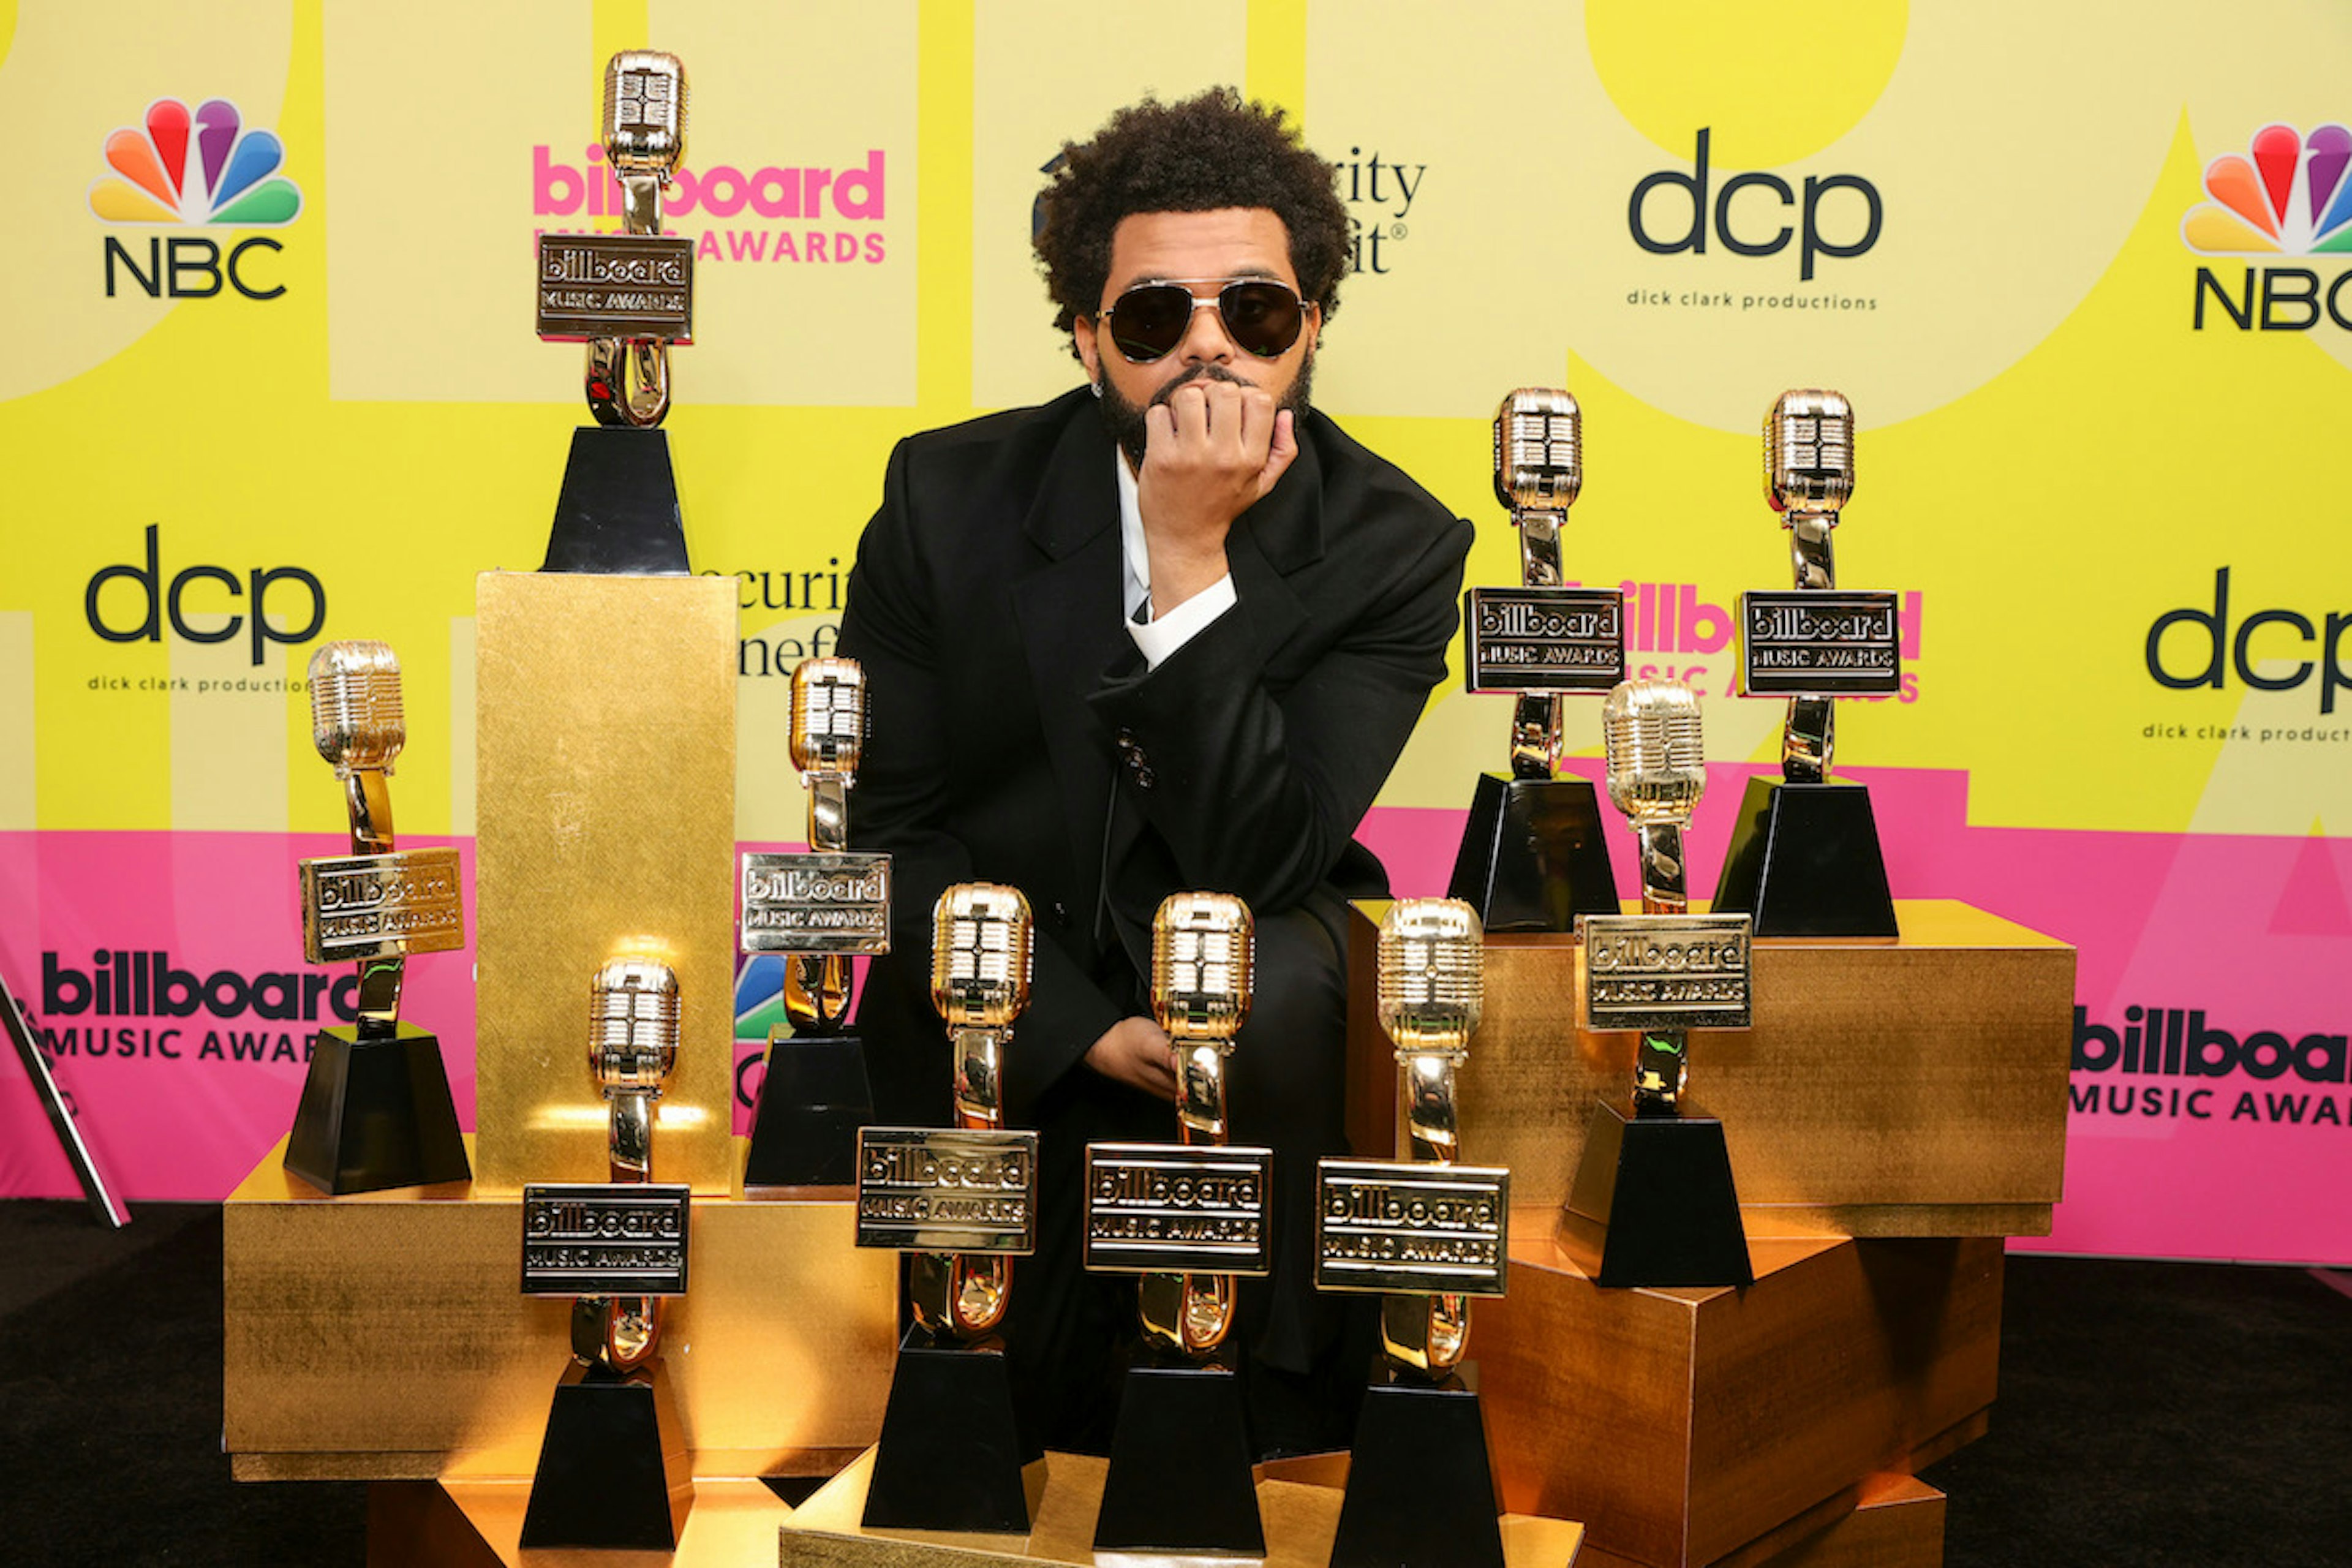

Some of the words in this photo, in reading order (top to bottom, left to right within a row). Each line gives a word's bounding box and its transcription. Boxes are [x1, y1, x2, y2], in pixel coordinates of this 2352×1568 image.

[1628, 126, 1883, 282] dcp
[697, 230, 886, 264] AWARDS
[105, 237, 287, 300] NBC
[542, 249, 687, 285] billboard
[541, 292, 602, 307] MUSIC
[604, 293, 685, 311] AWARDS
[1626, 290, 1672, 305] dick
[1681, 291, 1733, 306] clark
[1743, 293, 1877, 311] productions
[85, 524, 326, 666] dcp
[1479, 603, 1618, 638] billboard
[1751, 608, 1893, 640] billboard
[1480, 646, 1539, 664] MUSIC
[1542, 646, 1620, 665] AWARDS
[1752, 649, 1811, 667] MUSIC
[1815, 649, 1894, 668] AWARDS
[88, 676, 130, 691] dick
[138, 676, 189, 692] clark
[2143, 724, 2188, 738] dick
[2197, 725, 2251, 740] clark
[319, 865, 456, 910] billboard
[747, 869, 886, 902] billboard
[747, 908, 805, 927] MUSIC
[807, 908, 886, 928] AWARDS
[1592, 933, 1745, 972] billboard
[43, 1028, 182, 1058] MUSIC
[2070, 1005, 2352, 1084] billboa
[2070, 1084, 2214, 1118] MUSIC
[2231, 1091, 2352, 1127] AWA
[862, 1148, 1029, 1189] billboard
[1091, 1166, 1264, 1210] billboard
[526, 1202, 681, 1238] billboard
[861, 1197, 930, 1219] MUSIC
[932, 1199, 1026, 1223] AWARDS
[1324, 1185, 1499, 1231] billboard
[526, 1247, 590, 1267] MUSIC
[595, 1248, 684, 1267] AWARDS
